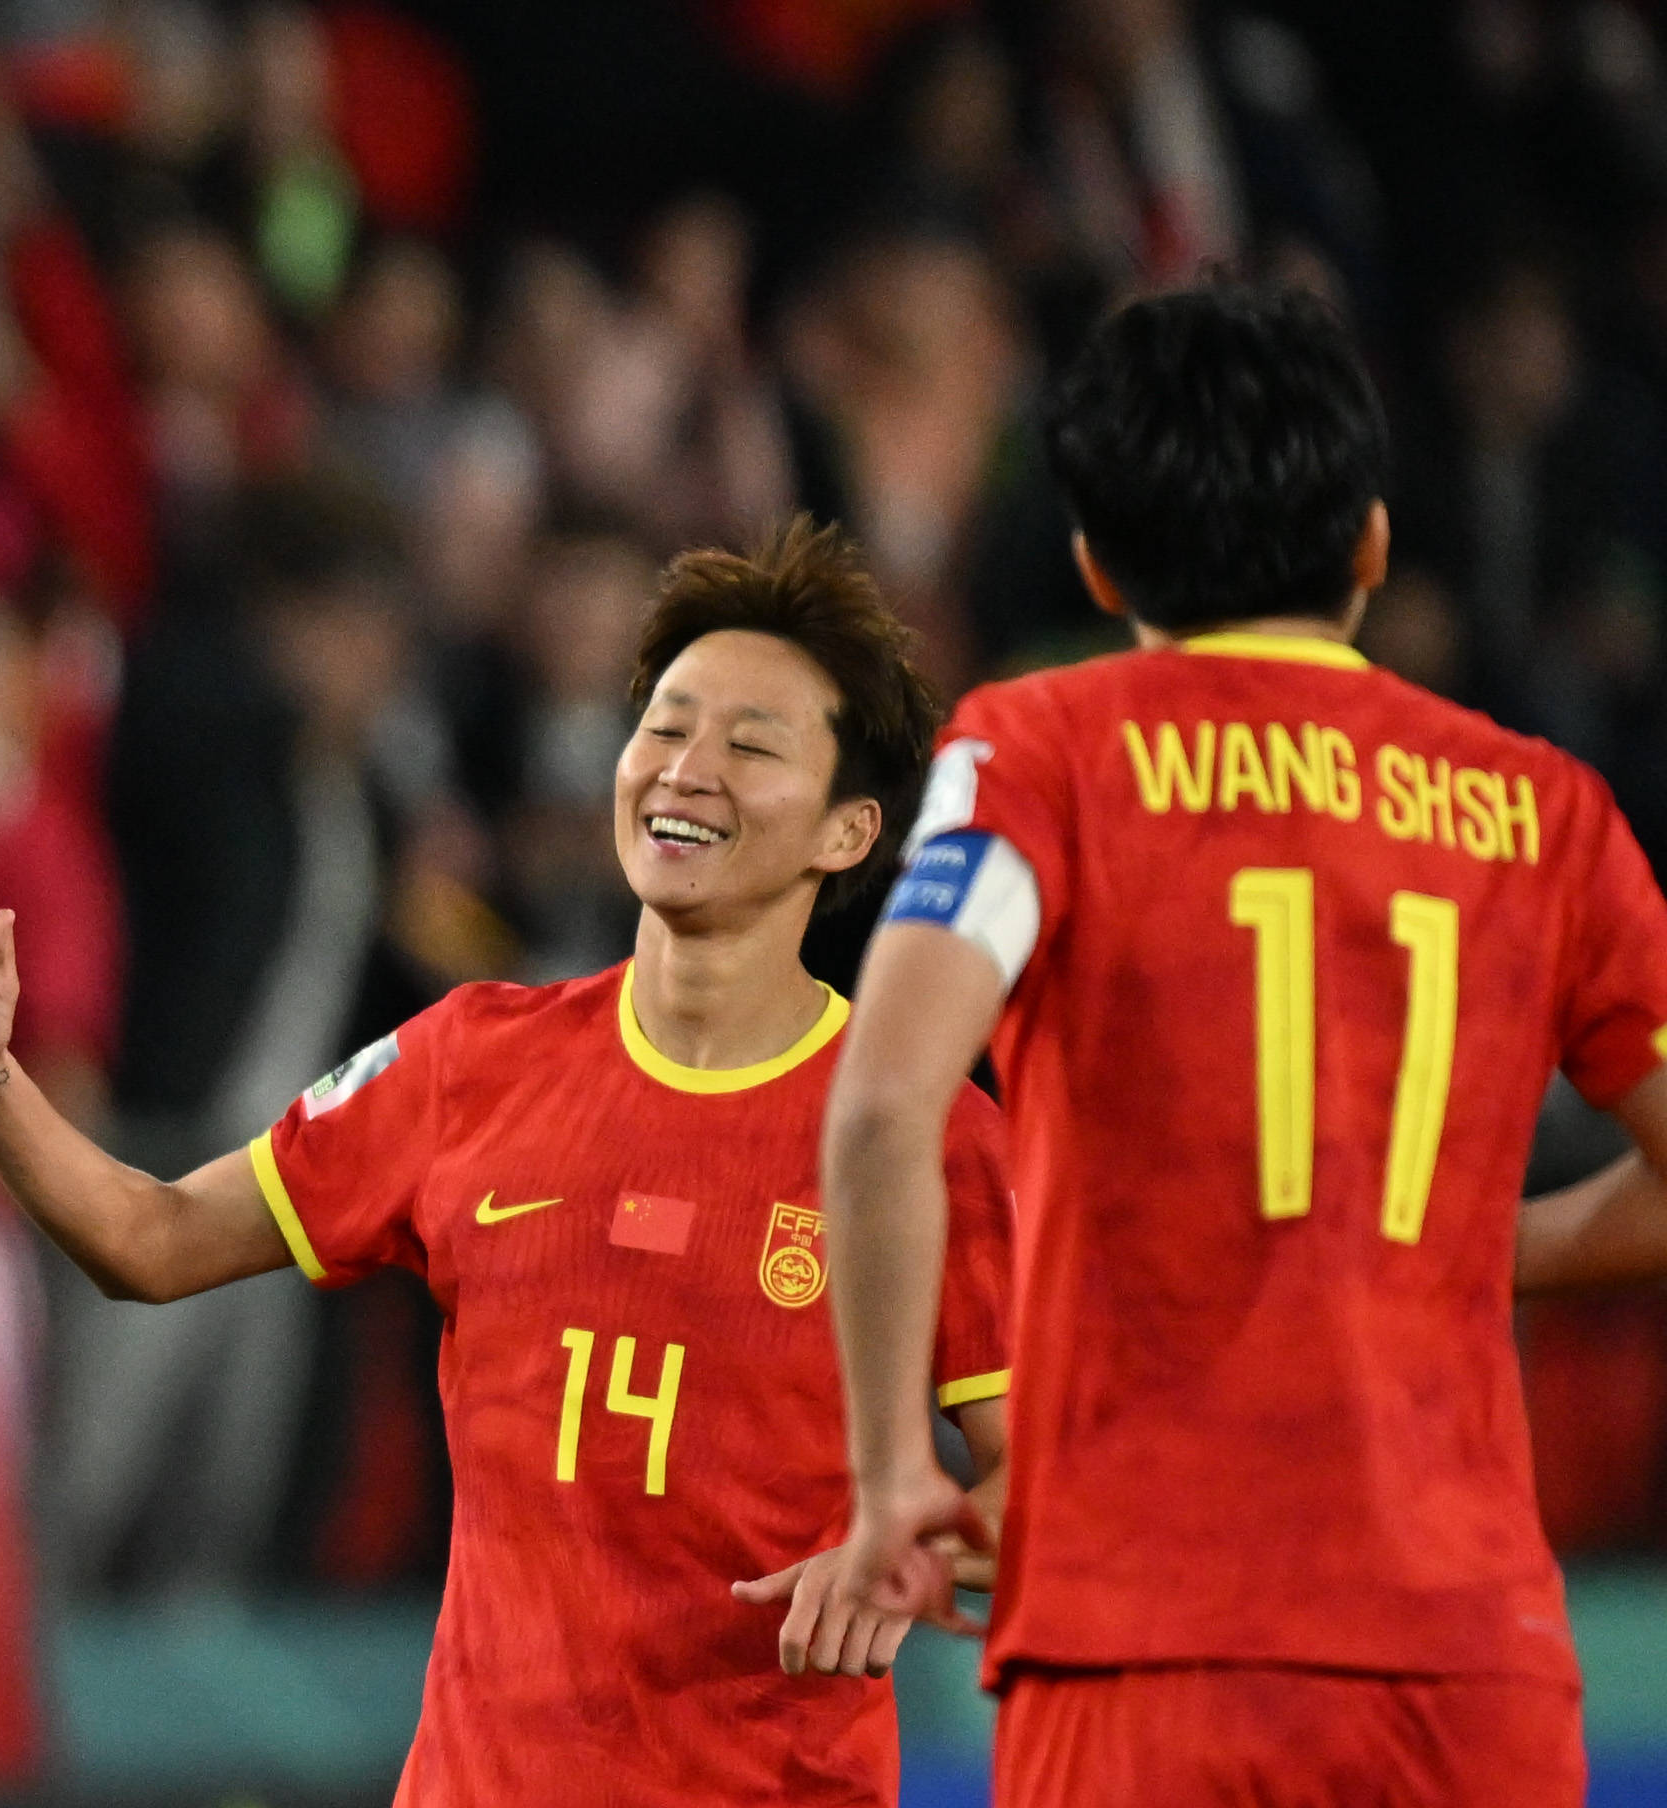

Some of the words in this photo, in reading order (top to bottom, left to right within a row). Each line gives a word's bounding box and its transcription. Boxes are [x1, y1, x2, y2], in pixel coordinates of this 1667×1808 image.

[1122, 719, 1362, 822] WANG
[1375, 743, 1540, 865] SHSH
[1229, 867, 1460, 1246] 11
[557, 1327, 685, 1496] 14
